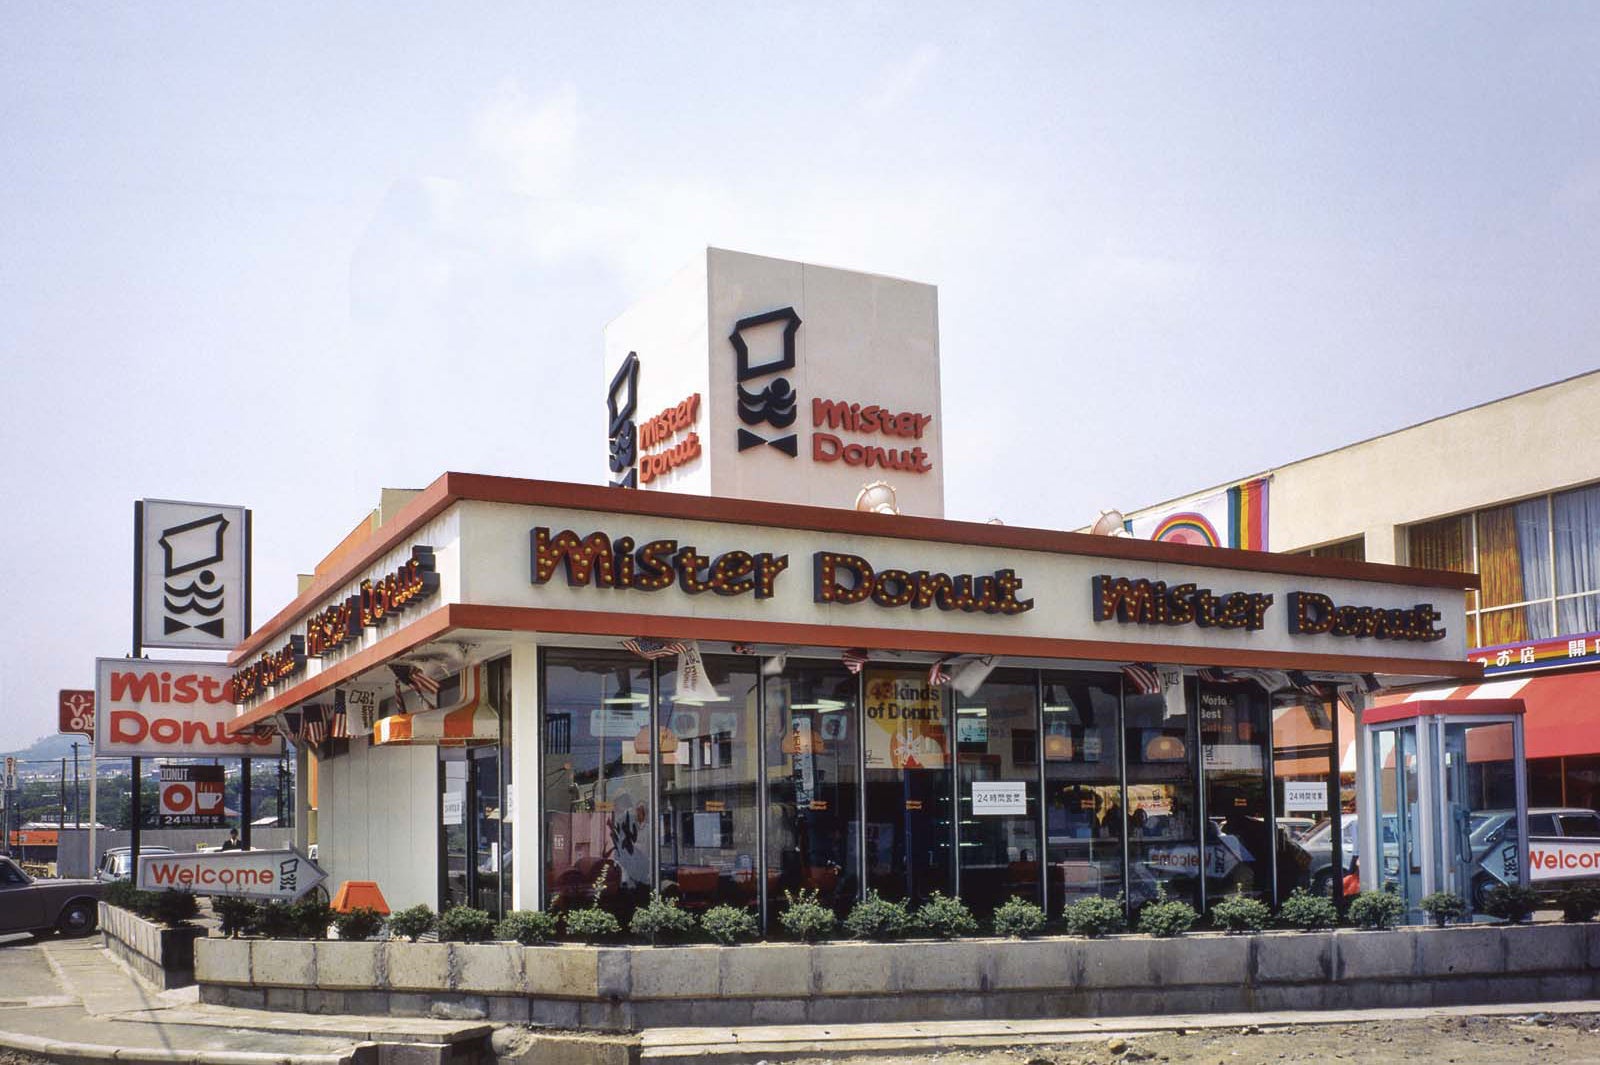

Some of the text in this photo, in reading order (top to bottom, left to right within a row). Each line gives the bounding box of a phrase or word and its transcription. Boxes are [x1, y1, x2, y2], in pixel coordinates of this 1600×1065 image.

[639, 393, 701, 450] Mister
[812, 397, 932, 439] Mister
[639, 432, 701, 483] Donut
[812, 432, 932, 473] Donut
[530, 526, 1034, 615] Mister Donut
[1092, 574, 1447, 642] Mister Donut
[110, 710, 273, 746] Donu
[867, 702, 885, 719] of
[151, 863, 274, 886] Welcome
